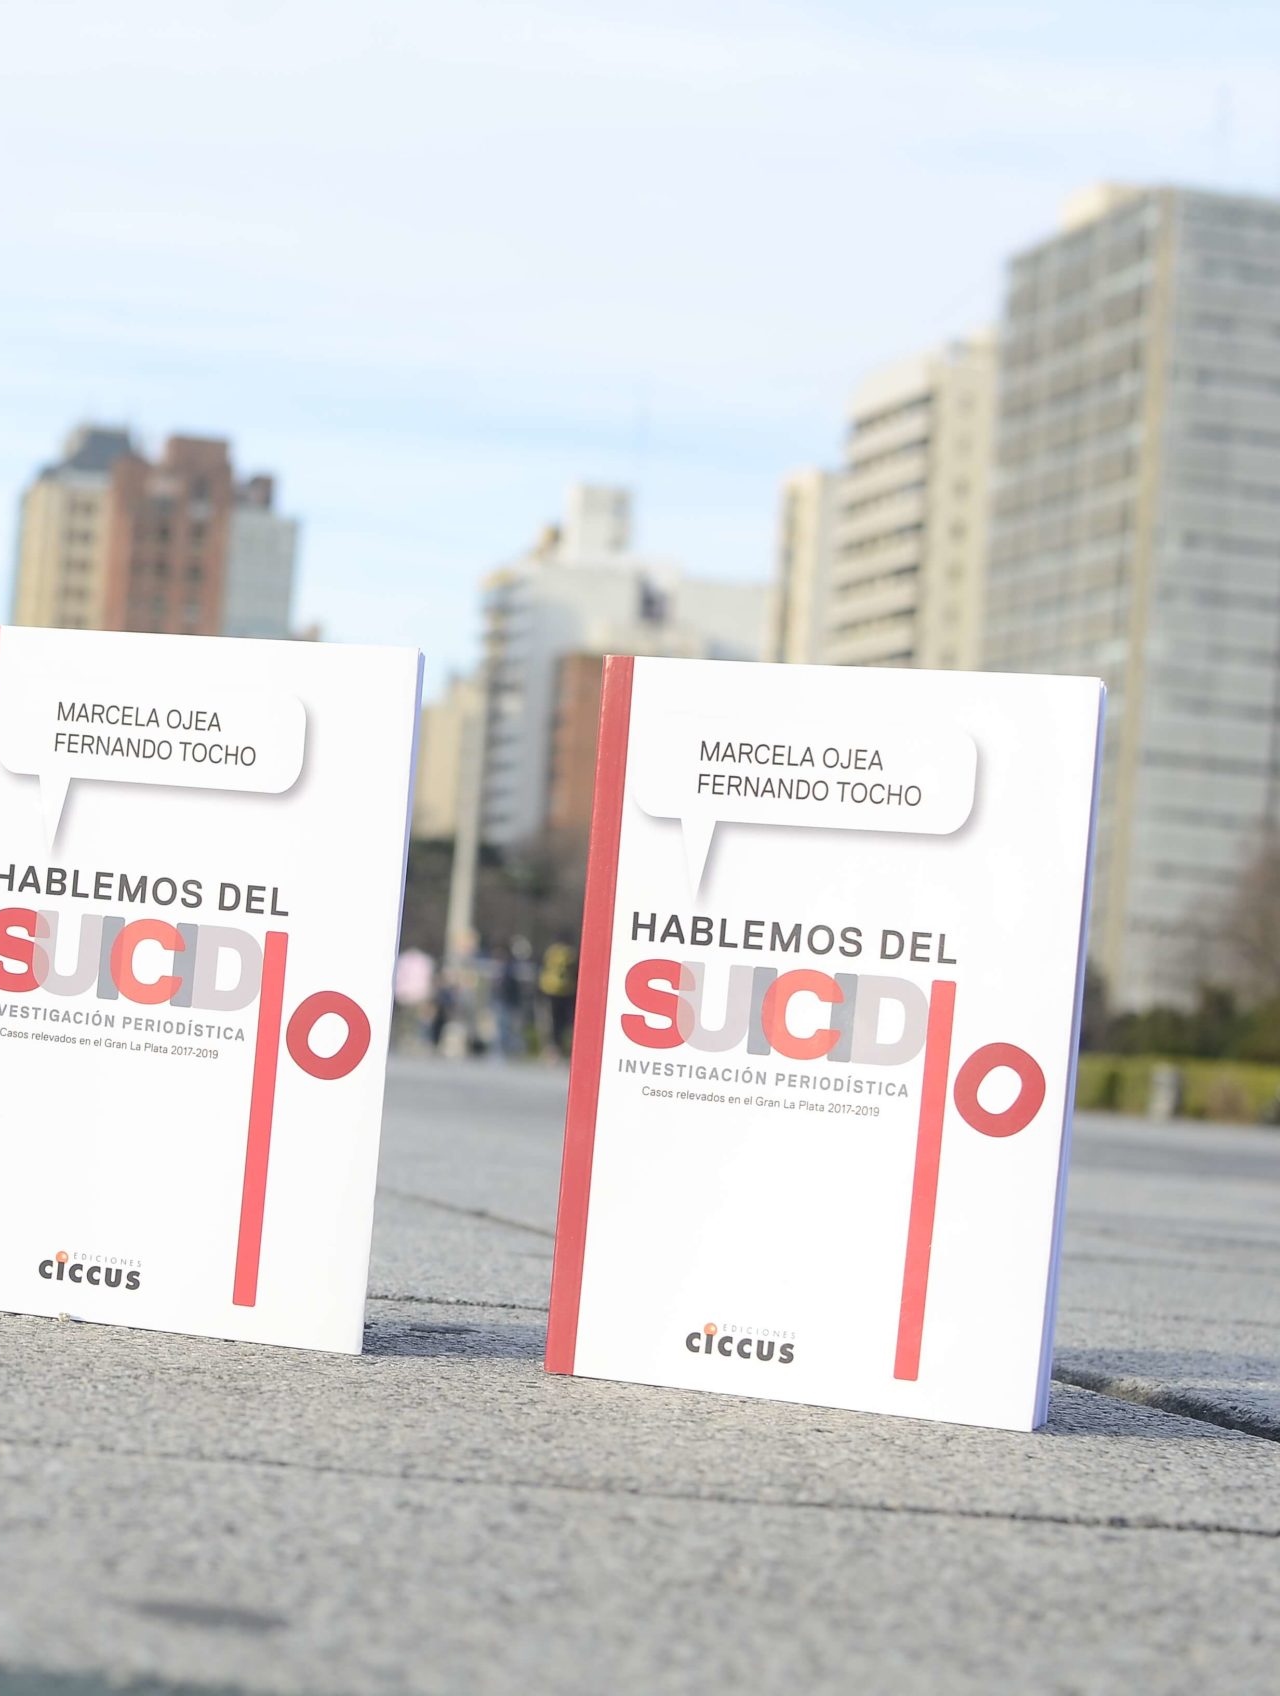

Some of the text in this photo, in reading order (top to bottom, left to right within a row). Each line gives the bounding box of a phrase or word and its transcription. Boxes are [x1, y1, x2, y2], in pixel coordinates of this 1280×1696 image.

[57, 702, 221, 732] MARCELA OJEA
[54, 733, 256, 766] FERNANDO TOCHO
[700, 741, 883, 771] MARCELA OJEA
[697, 774, 921, 806] FERNANDO TOCHO
[218, 883, 288, 916] DEL
[631, 912, 956, 964] HABLEMOS DEL
[0, 1027, 219, 1060] Casos relevados en el Gran La Plata 2017-2019
[121, 1016, 244, 1041] PERIODÍSTICA
[618, 1059, 908, 1097] INVESTIGACIÓN PERIODÍSTICA
[641, 1085, 880, 1118] Casos relevados en el Gran La Plata 2017-2019
[73, 1251, 142, 1268] EDICIONES
[722, 1323, 796, 1341] EDICIONES
